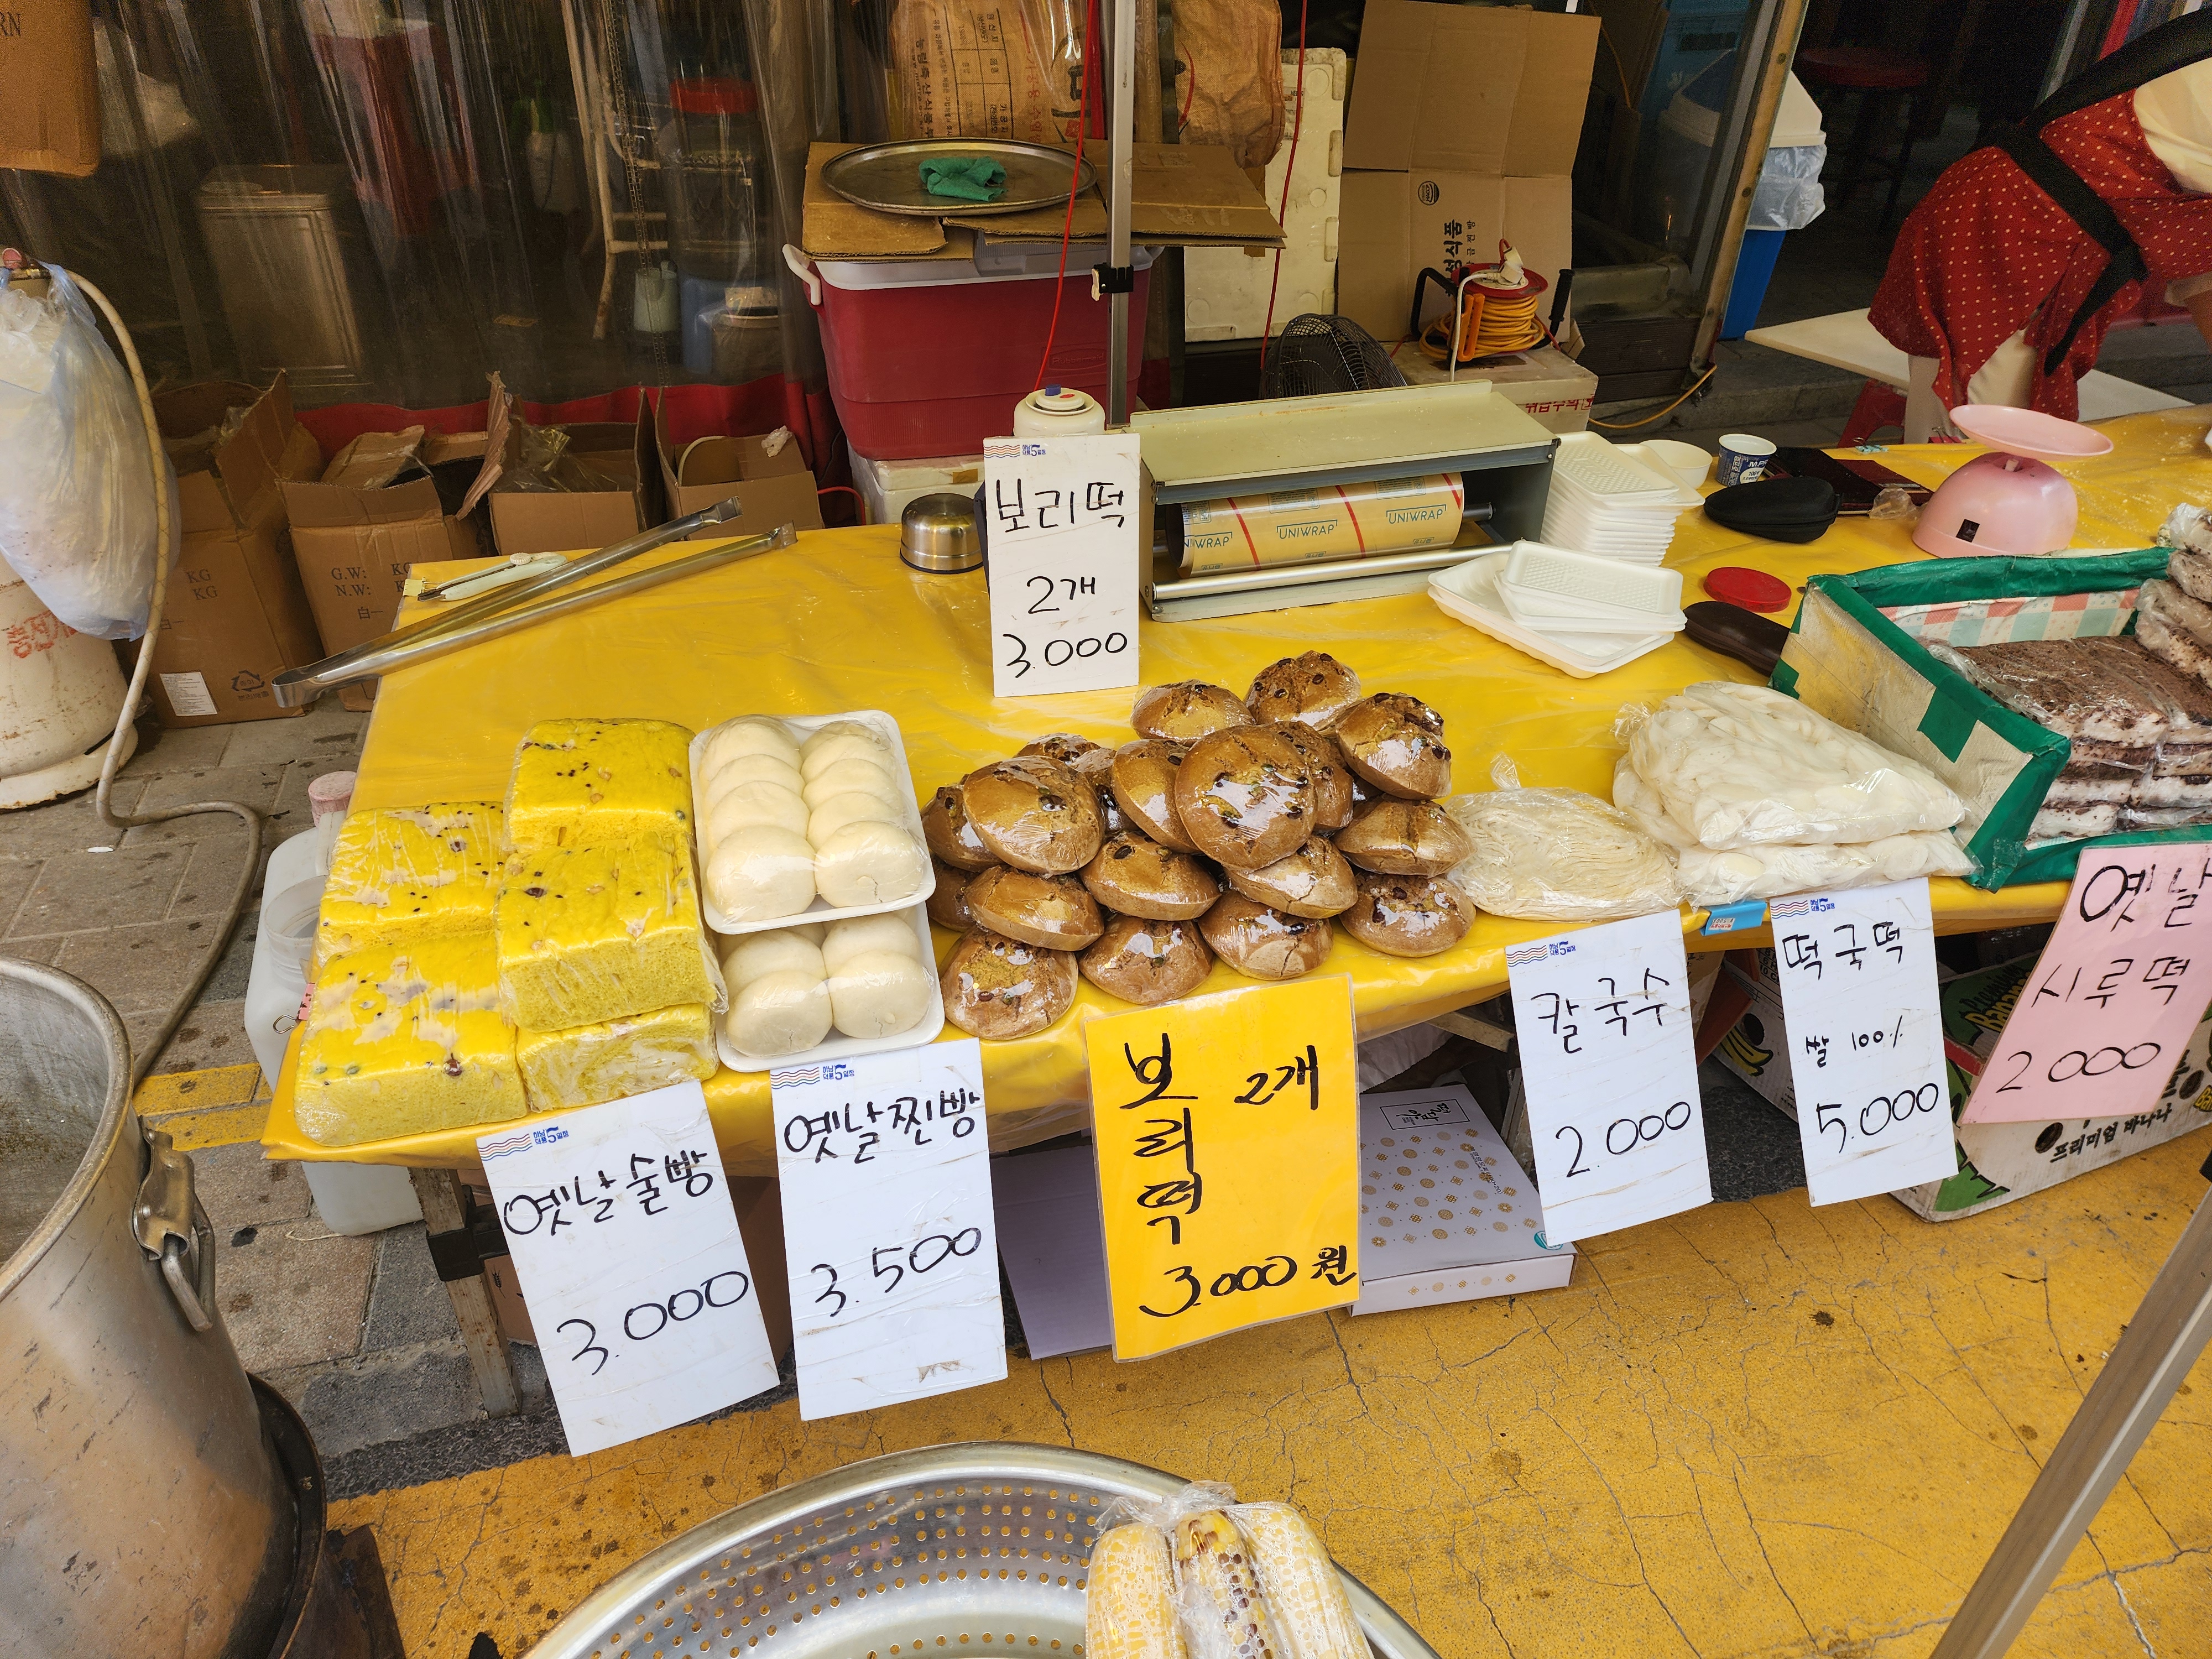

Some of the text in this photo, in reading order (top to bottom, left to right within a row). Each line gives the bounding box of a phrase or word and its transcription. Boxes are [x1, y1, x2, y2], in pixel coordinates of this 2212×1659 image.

[1051, 352, 1104, 366] Rubbermaid
[996, 478, 1124, 534] 보리떡
[1279, 524, 1334, 539] UNIWRAP
[1388, 509, 1443, 525] UNIWRAP
[1184, 536, 1229, 549] NIWRAP
[186, 568, 211, 584] KG
[192, 585, 218, 601] KG
[331, 566, 367, 581] G.W:
[335, 585, 372, 597] N.W:
[1026, 576, 1097, 614] 2개
[2079, 857, 2212, 933] 옛날
[1782, 921, 1903, 980] 떡국떡
[1530, 967, 1670, 1054] 칼국수
[2031, 956, 2191, 1009] 시루떡
[1234, 1044, 1319, 1111] 2개
[1806, 1035, 1829, 1068] 쌀
[784, 1087, 980, 1164] 옛날찐빵
[1119, 1032, 1203, 1245] 보리떡
[1556, 1101, 1692, 1178] 2.000
[1816, 1082, 1939, 1154] 5.000
[2049, 1102, 2173, 1163] 프리미엄 바나나
[503, 1149, 714, 1237] 옛날술빵
[810, 1227, 982, 1318] 3.500
[556, 1271, 749, 1376] 3.000
